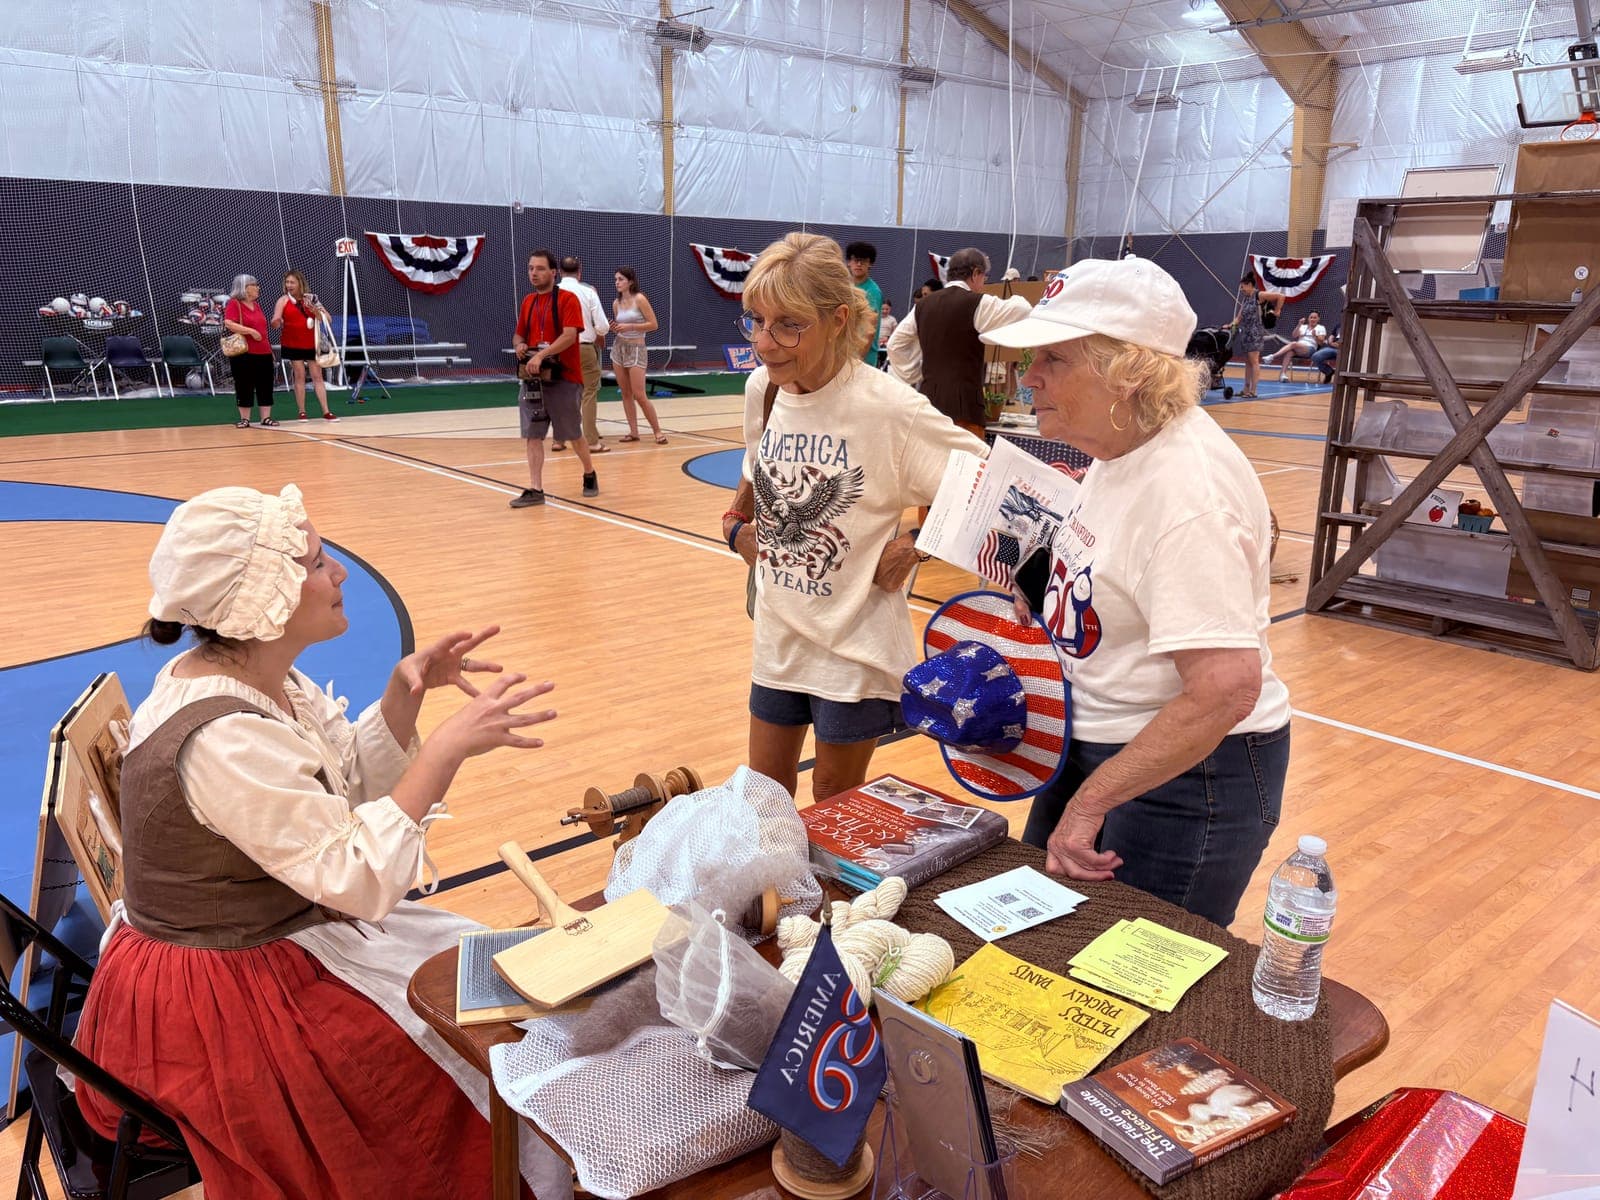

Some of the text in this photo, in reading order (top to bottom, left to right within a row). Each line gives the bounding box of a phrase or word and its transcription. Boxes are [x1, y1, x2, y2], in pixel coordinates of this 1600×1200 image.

[338, 240, 355, 254] EXIT
[761, 428, 849, 470] AMERICA
[771, 568, 833, 597] YEARS
[1085, 624, 1098, 633] TH
[814, 807, 882, 836] Fiber
[836, 802, 905, 832] SOURCEBOOK
[1008, 963, 1055, 991] PANTS
[1062, 988, 1124, 1019] PRICKLY
[1058, 1006, 1121, 1039] PETER'S
[1080, 1089, 1114, 1116] Guide
[1108, 1116, 1143, 1140] Field
[1120, 1108, 1176, 1152] to Fleece
[1140, 1136, 1166, 1161] The
